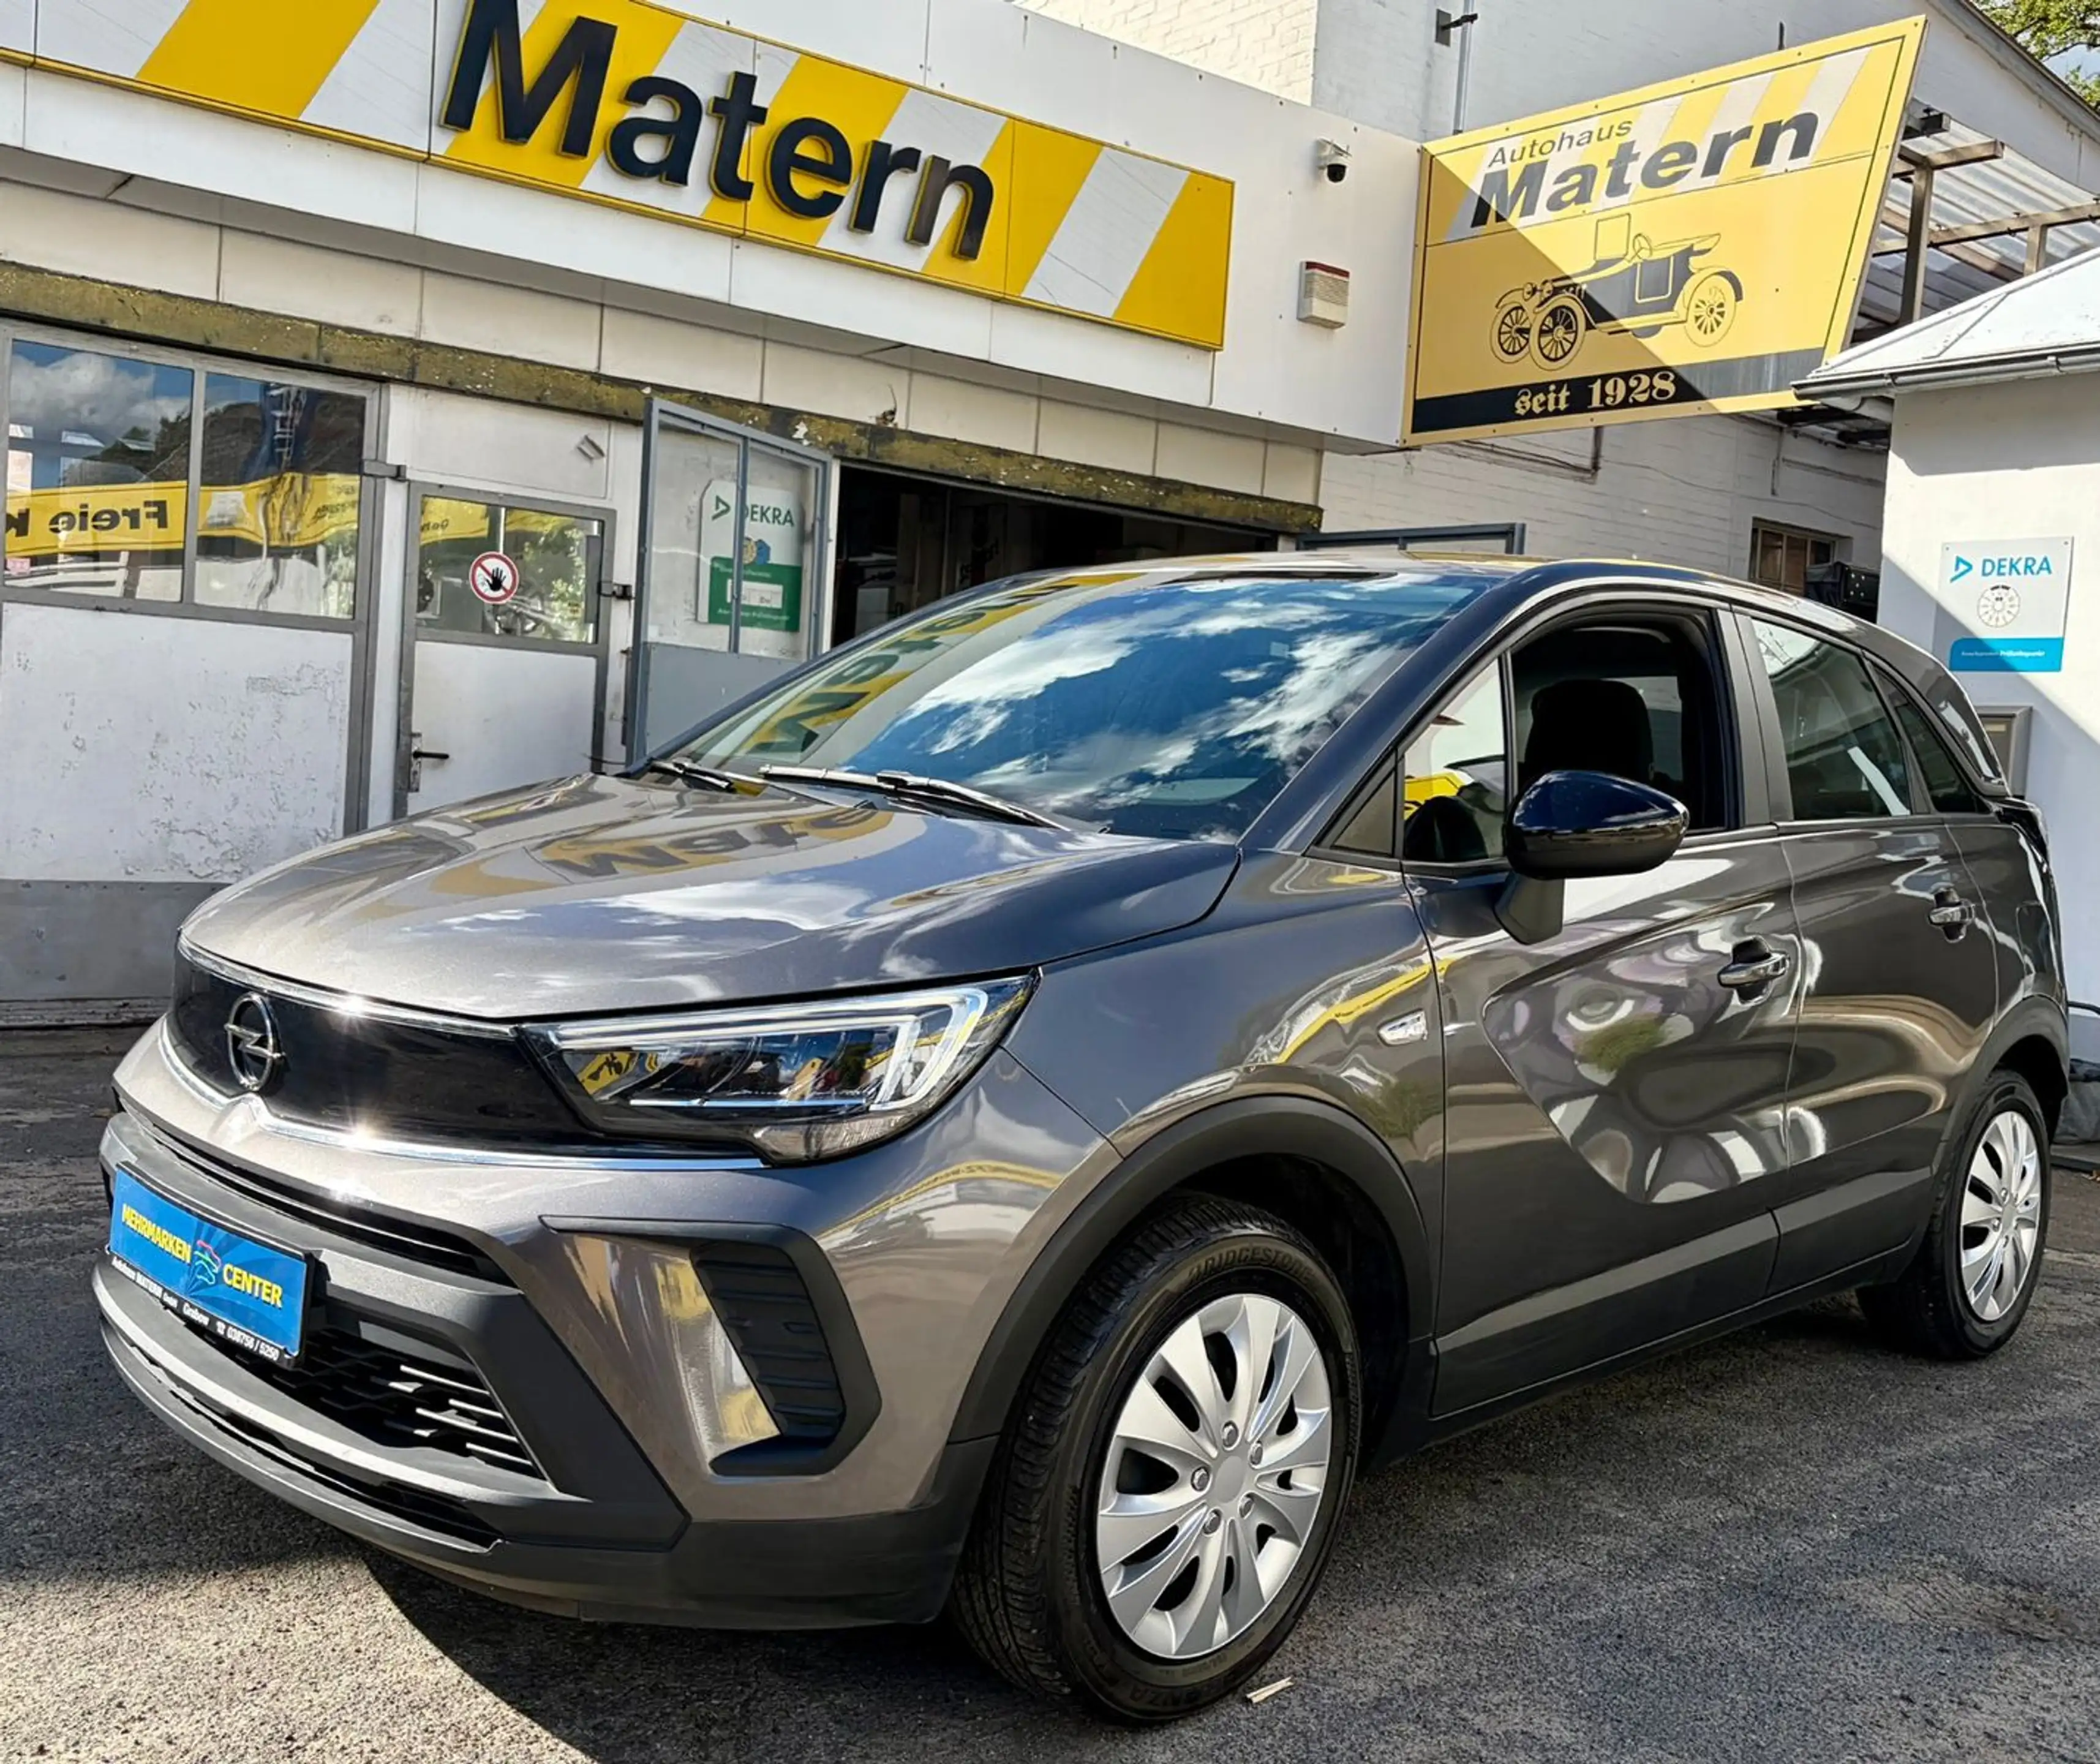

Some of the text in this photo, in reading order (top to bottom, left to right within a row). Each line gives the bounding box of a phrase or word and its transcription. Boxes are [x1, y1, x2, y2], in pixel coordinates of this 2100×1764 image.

[440, 0, 995, 260] Matern
[1488, 120, 1633, 168] Autohaus
[1470, 110, 1820, 228] Matern
[1514, 371, 1676, 416] seit 1928
[1981, 555, 2052, 577] DEKRA
[122, 1203, 283, 1308] MEHRMARKEN CENTER
